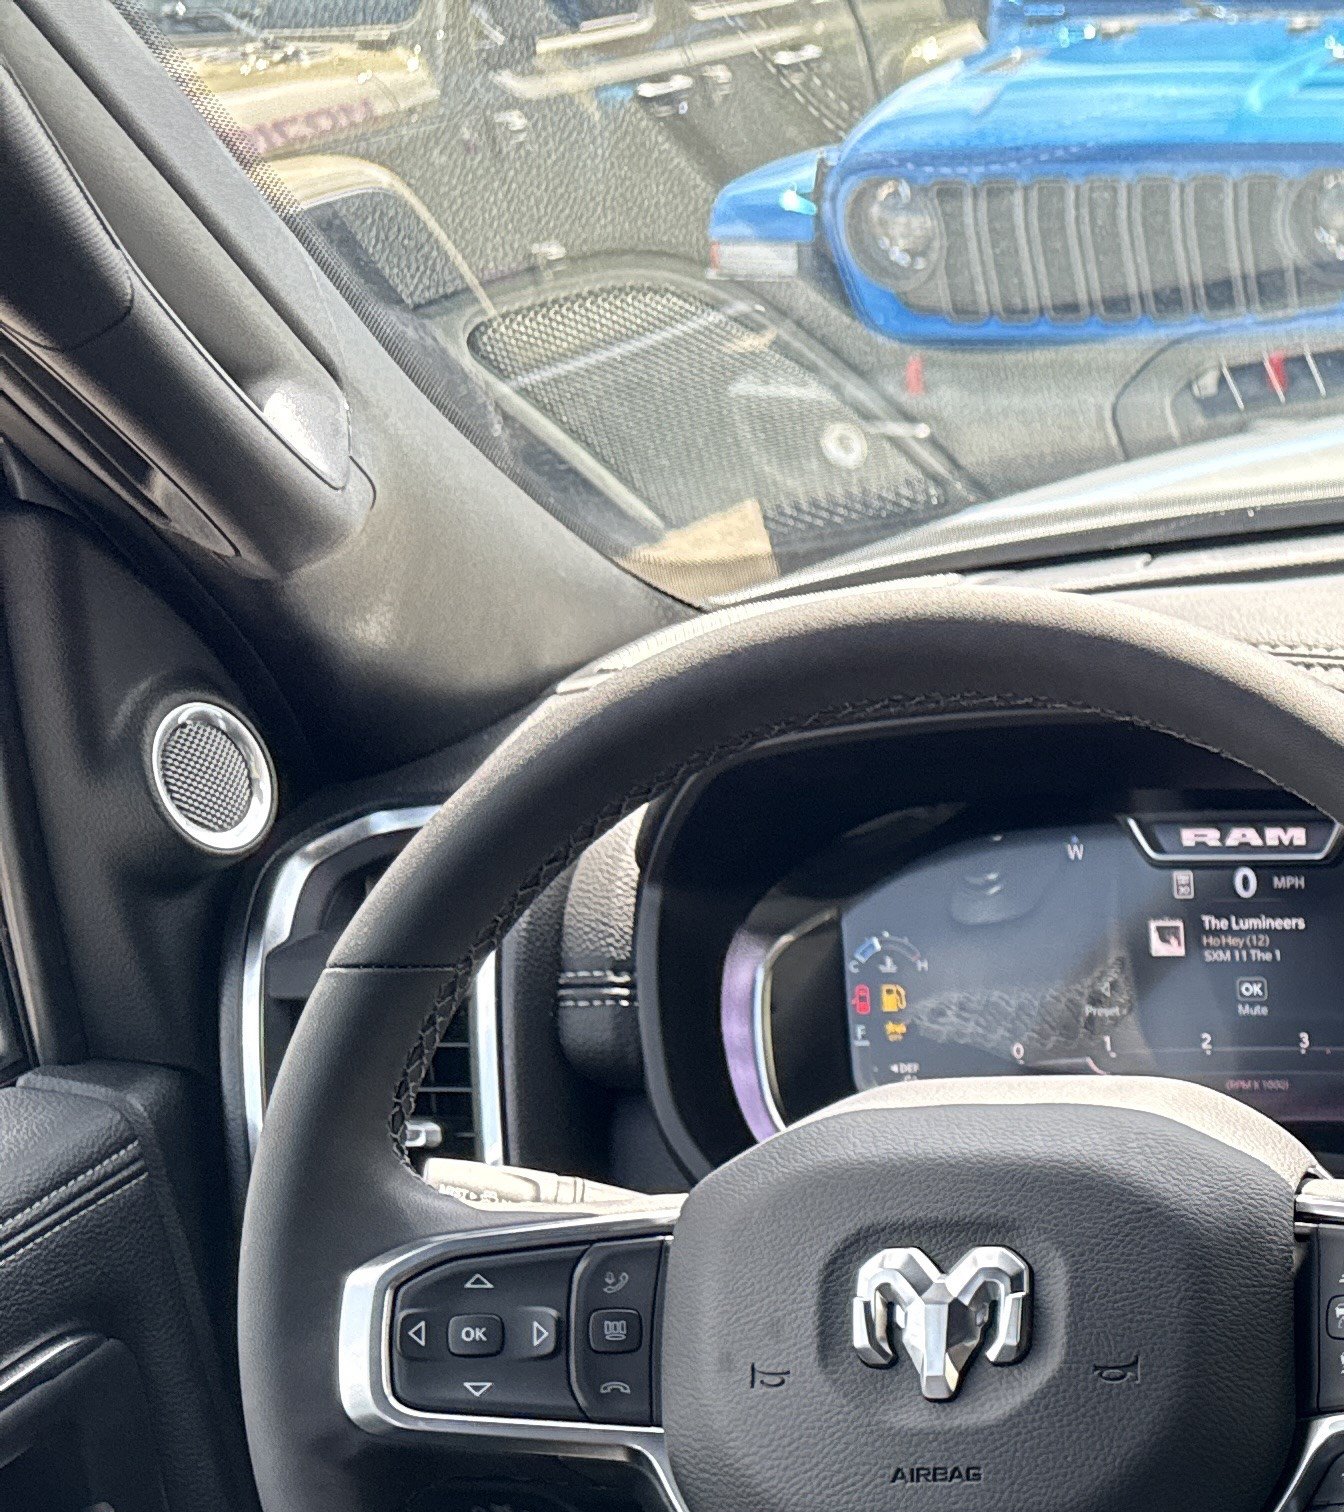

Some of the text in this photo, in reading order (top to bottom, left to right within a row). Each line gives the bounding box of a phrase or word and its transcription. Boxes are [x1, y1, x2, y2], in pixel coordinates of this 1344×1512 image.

[1180, 827, 1307, 847] RAM
[1066, 843, 1085, 860] W
[1234, 866, 1306, 899] 0 MPH
[1201, 914, 1306, 931] The Lumineers
[1203, 934, 1270, 949] Ho Hey (12)
[1203, 949, 1281, 962] SXM 11 The 1
[849, 959, 860, 974] C
[917, 958, 929, 972] H
[1240, 983, 1262, 997] OK
[1237, 1003, 1269, 1016] Mute
[856, 1024, 867, 1039] F
[1103, 1034, 1112, 1052] 1
[1201, 1032, 1212, 1050] 2
[1299, 1032, 1310, 1049] 3
[1011, 1042, 1025, 1060] 0
[460, 1326, 488, 1343] OK
[889, 1465, 983, 1484] AIRBAG
